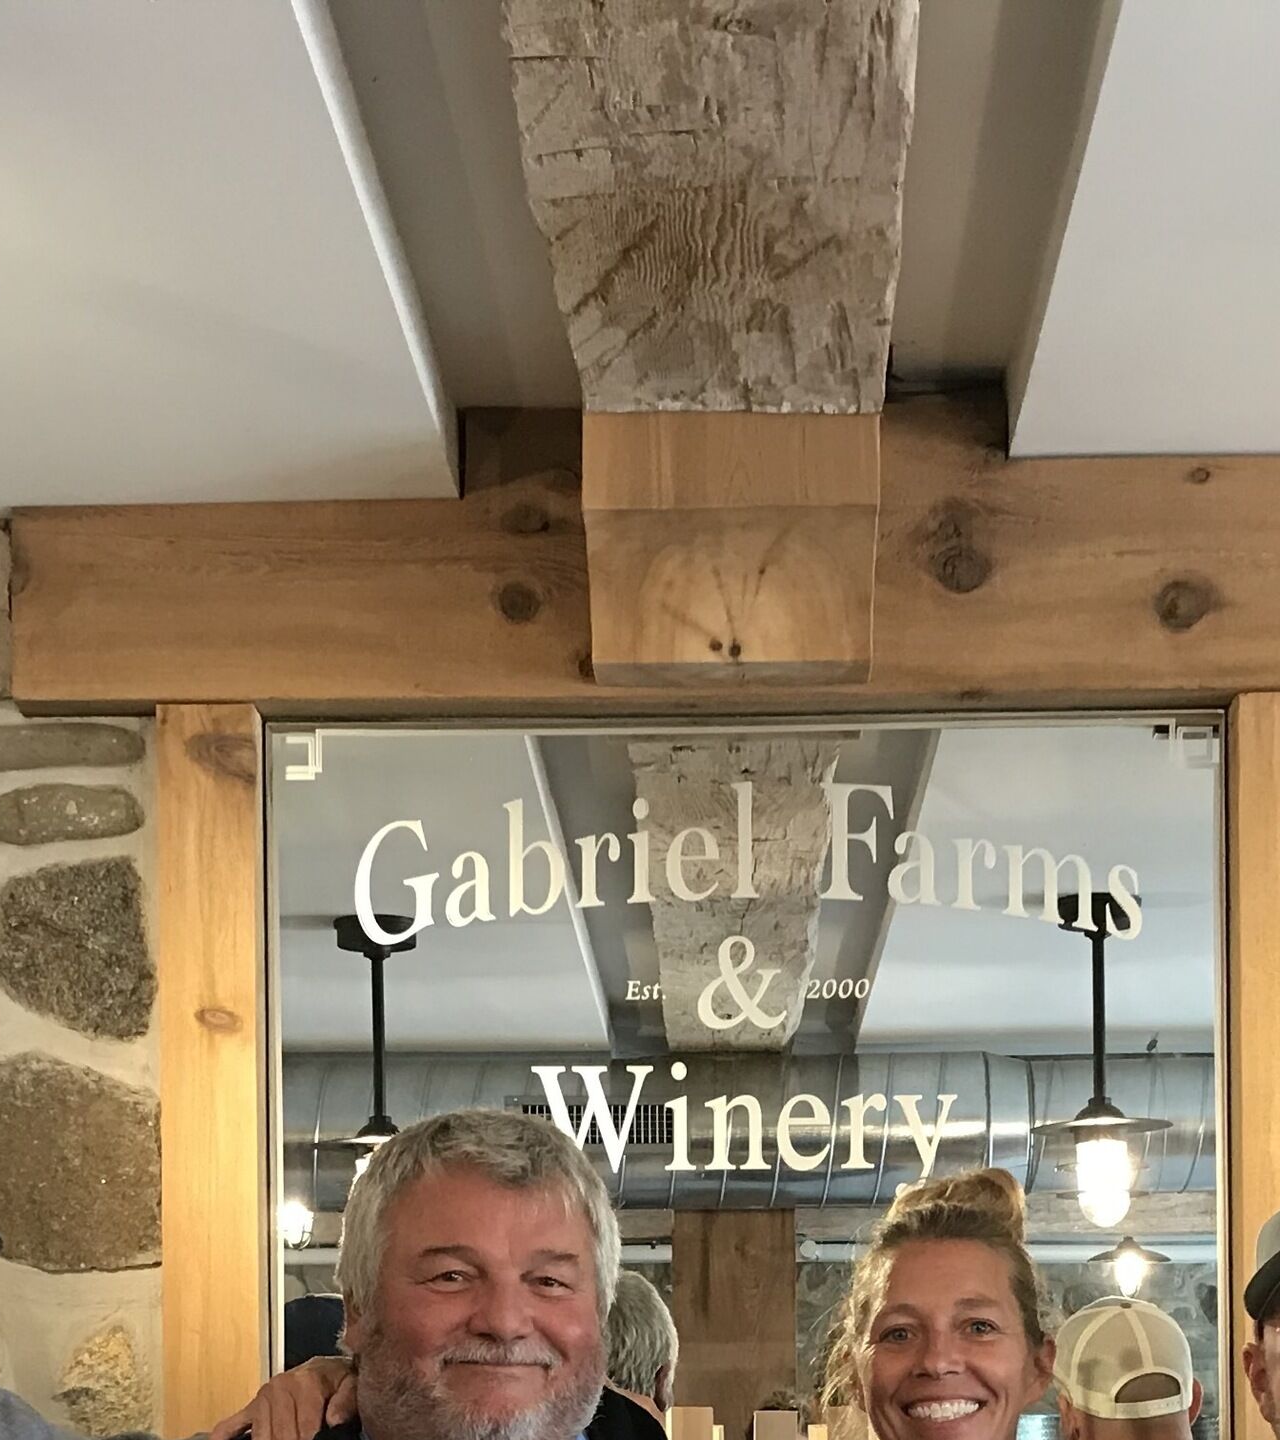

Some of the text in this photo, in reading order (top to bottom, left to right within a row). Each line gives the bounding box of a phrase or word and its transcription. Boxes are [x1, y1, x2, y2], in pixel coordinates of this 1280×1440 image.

[352, 781, 1144, 947] Gabriel Farms
[626, 935, 870, 1030] Est. & 2000
[531, 1060, 959, 1196] Winery
